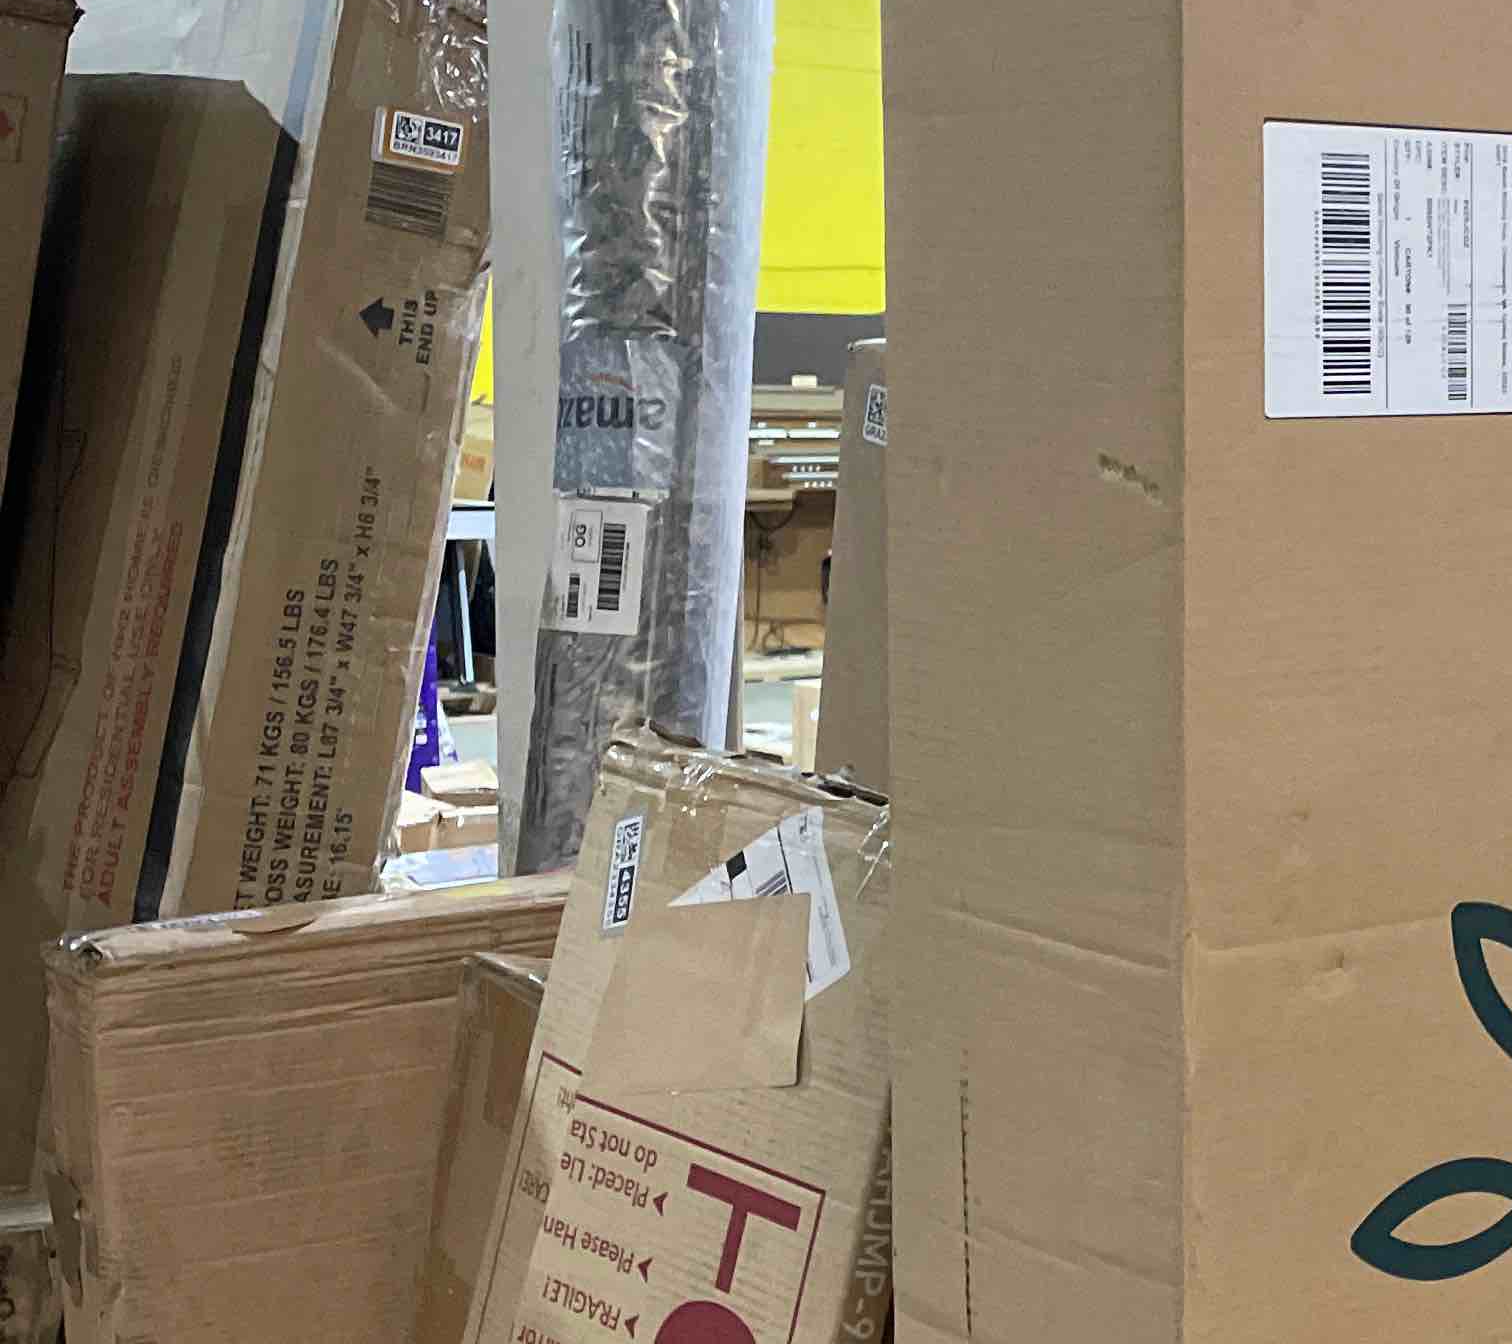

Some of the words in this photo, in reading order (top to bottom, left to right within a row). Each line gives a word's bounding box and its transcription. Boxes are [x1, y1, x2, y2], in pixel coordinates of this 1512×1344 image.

[426, 127, 458, 145] 3417
[398, 299, 419, 347] THIS
[423, 290, 439, 317] UP
[416, 322, 435, 365] END
[559, 396, 667, 431] amaz
[575, 523, 587, 548] OG
[315, 559, 338, 601] LBS
[281, 588, 305, 633] LBS
[307, 607, 330, 657] 176.4
[336, 610, 358, 651] W47
[271, 637, 297, 692] 156.5
[295, 679, 319, 725] KGS
[260, 711, 285, 756] KGS
[290, 732, 311, 755] 80
[256, 765, 276, 787] 71
[272, 761, 306, 850] WEIGHT:
[239, 793, 272, 882] WEIGHT:
[97, 819, 127, 906] ADULT
[264, 859, 289, 907] OSS
[616, 868, 633, 919] 4355
[571, 1119, 598, 1148] Sta
[600, 1130, 631, 1157] not
[561, 1152, 585, 1183] Lie
[634, 1145, 657, 1173] do
[588, 1164, 649, 1208] Placed:
[543, 1215, 577, 1249] Han
[581, 1230, 635, 1274] Please
[542, 1274, 621, 1330] FRAGILE!
